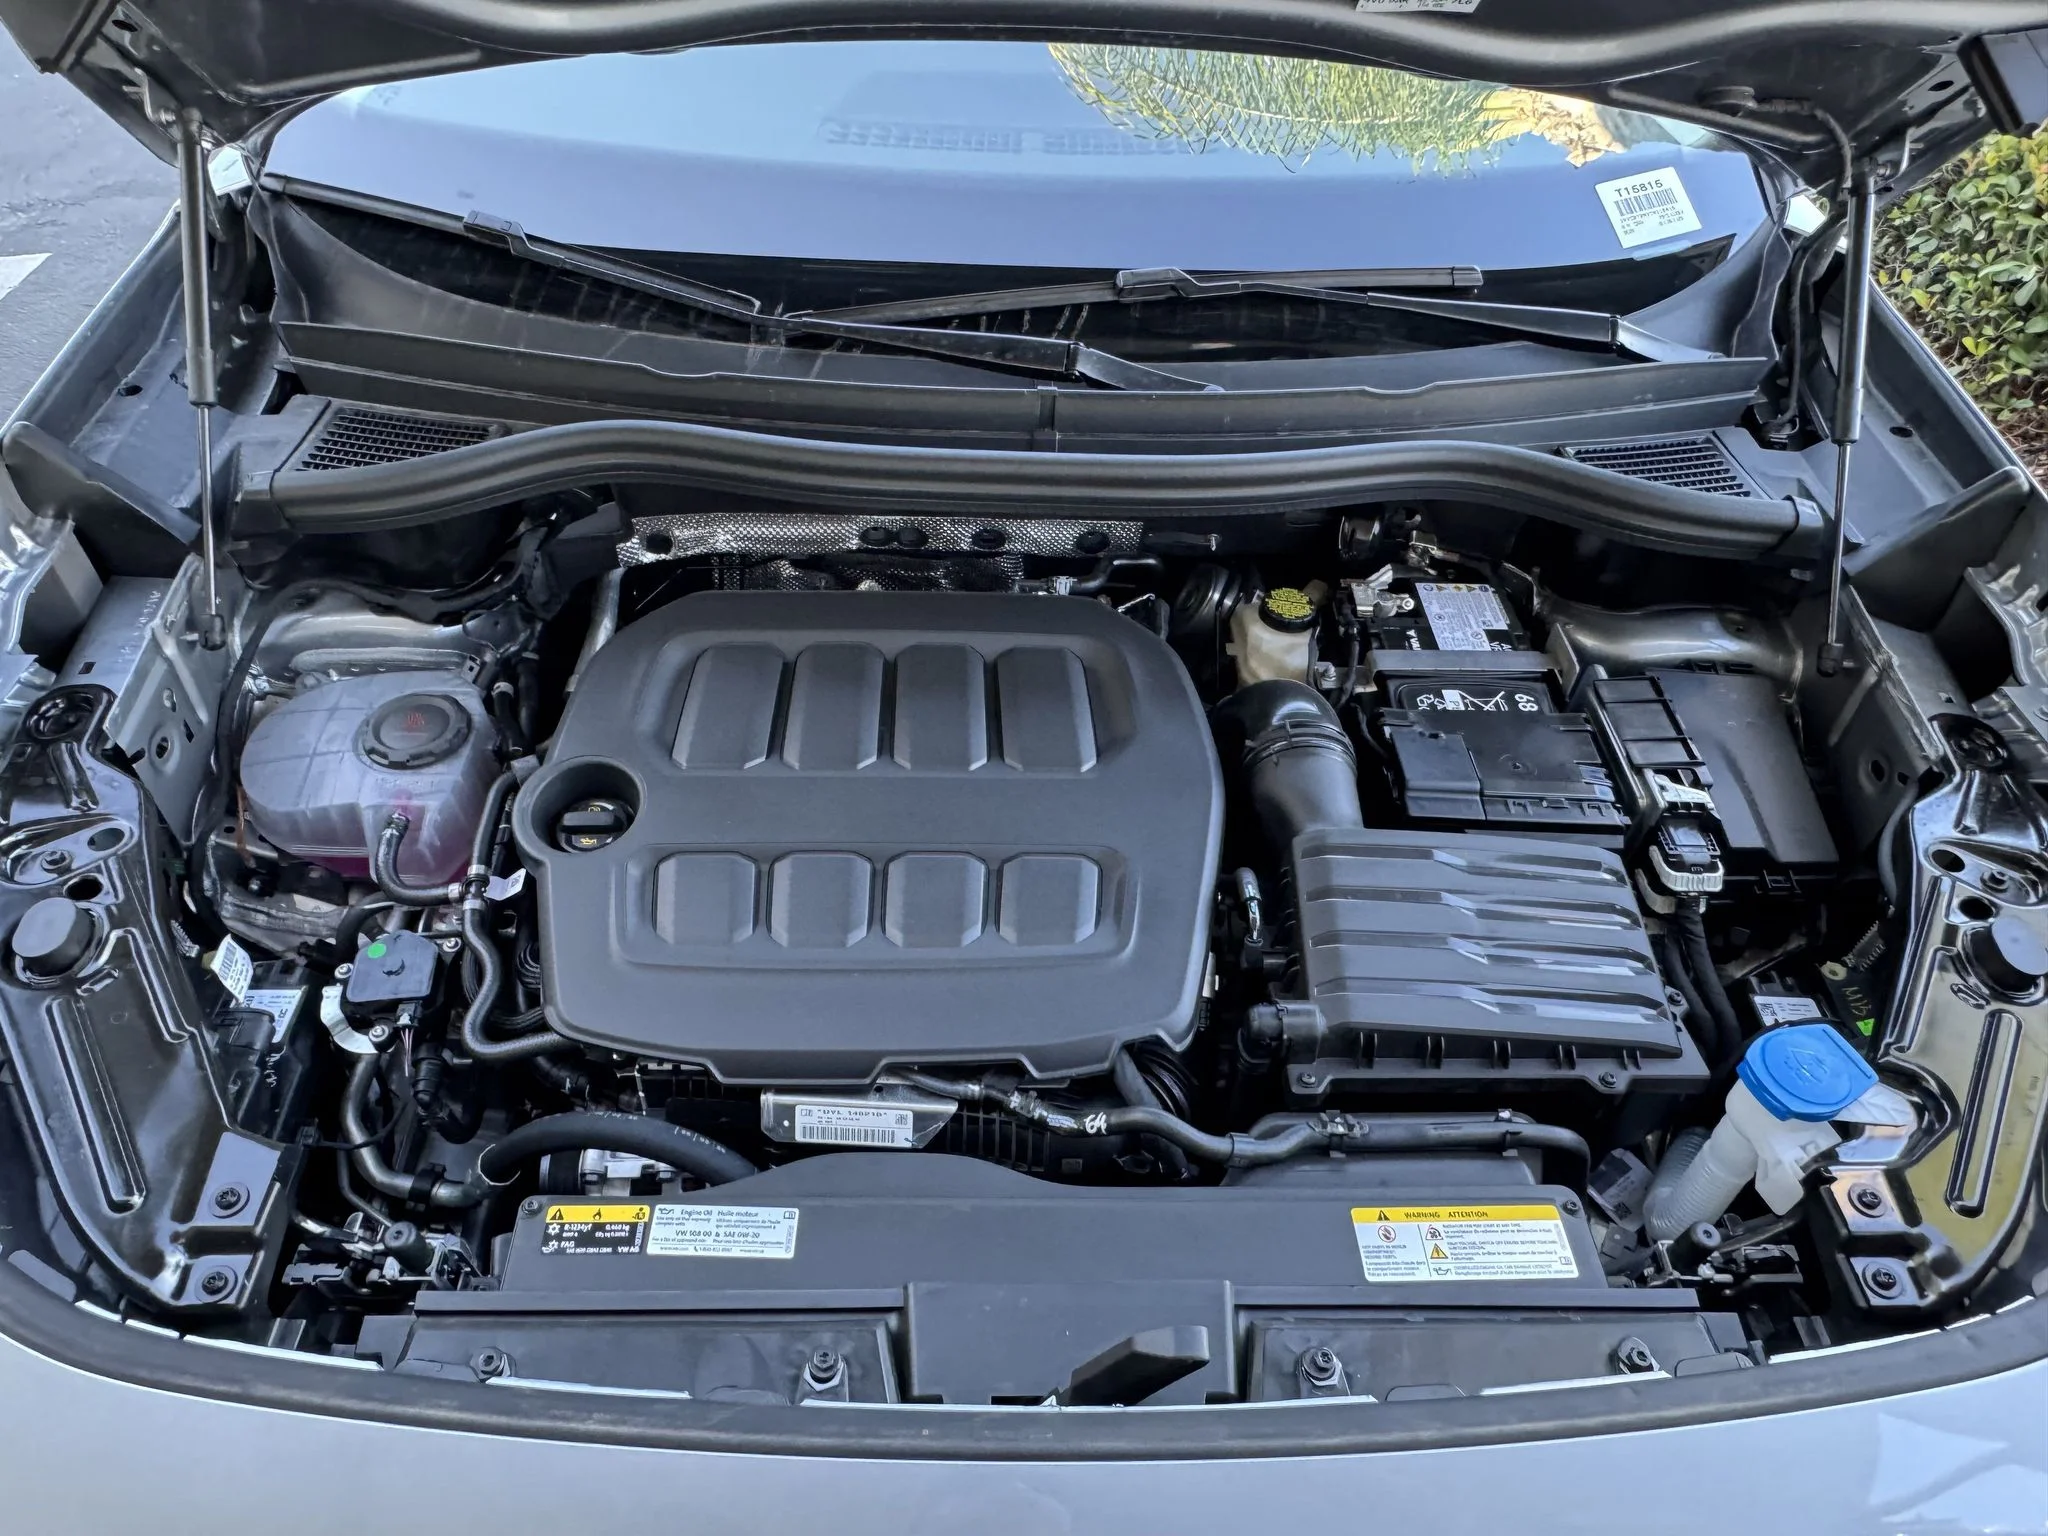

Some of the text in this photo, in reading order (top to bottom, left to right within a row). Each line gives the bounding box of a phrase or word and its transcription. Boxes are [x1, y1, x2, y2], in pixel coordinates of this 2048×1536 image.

[681, 1208, 702, 1217] Engine
[1404, 1210, 1489, 1219] WARNING ATTENTION
[675, 1229, 688, 1237] VW
